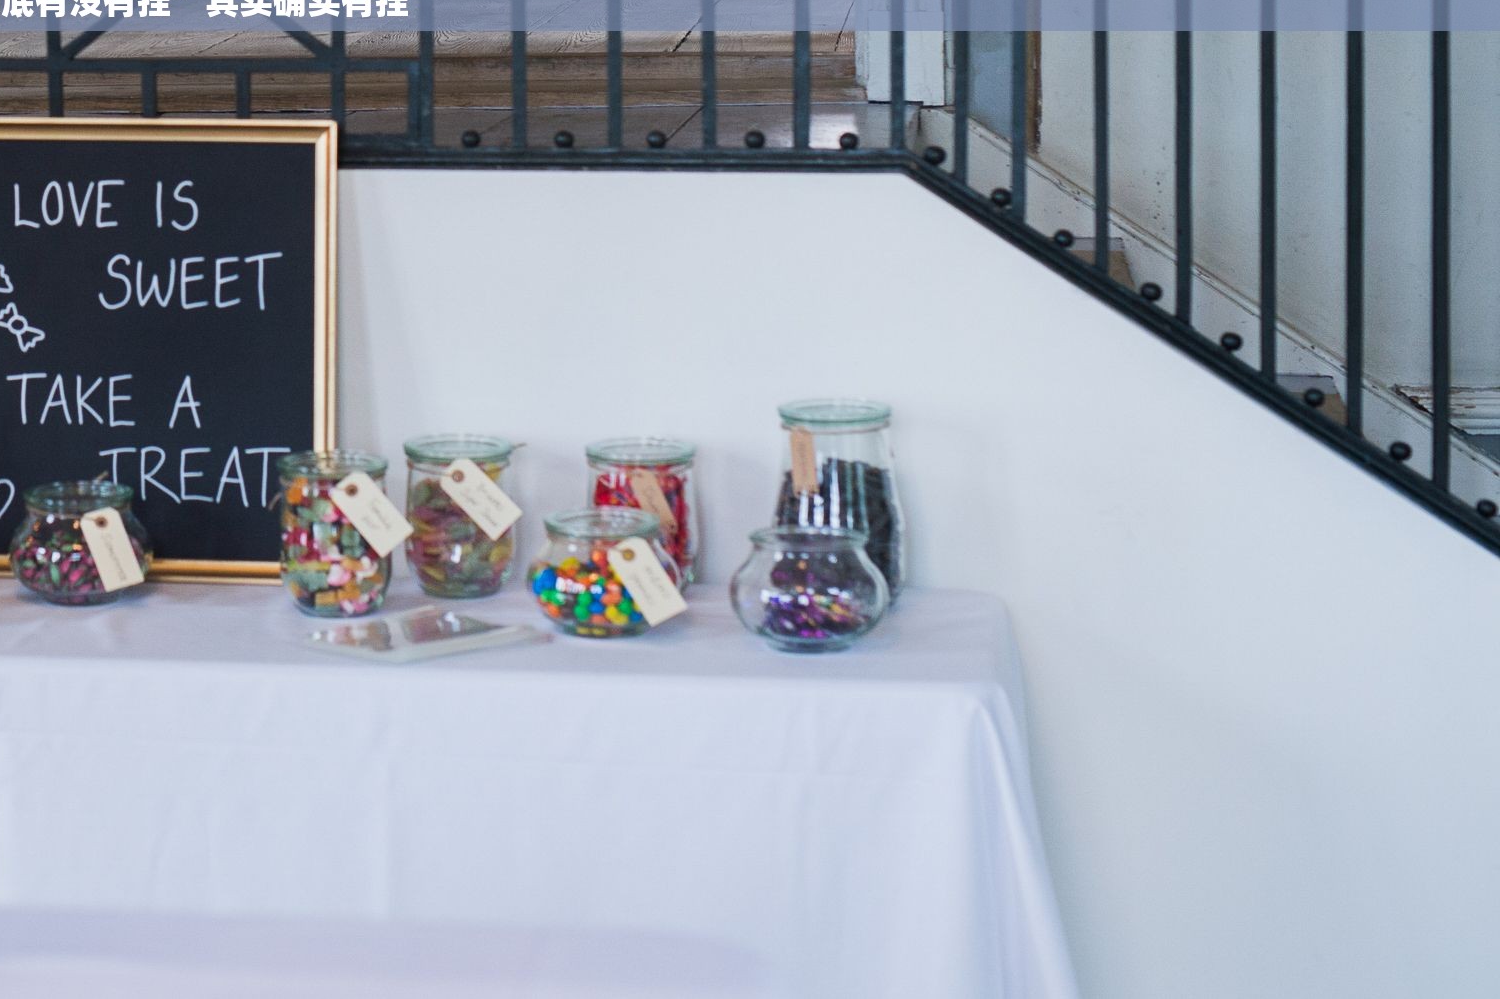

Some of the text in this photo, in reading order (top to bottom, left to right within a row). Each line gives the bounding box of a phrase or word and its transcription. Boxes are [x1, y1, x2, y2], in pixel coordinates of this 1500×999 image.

[13, 179, 199, 232] LOVE IS
[98, 251, 283, 311] SWEET
[6, 372, 201, 429] TAKE A
[98, 445, 291, 508] TREAT
